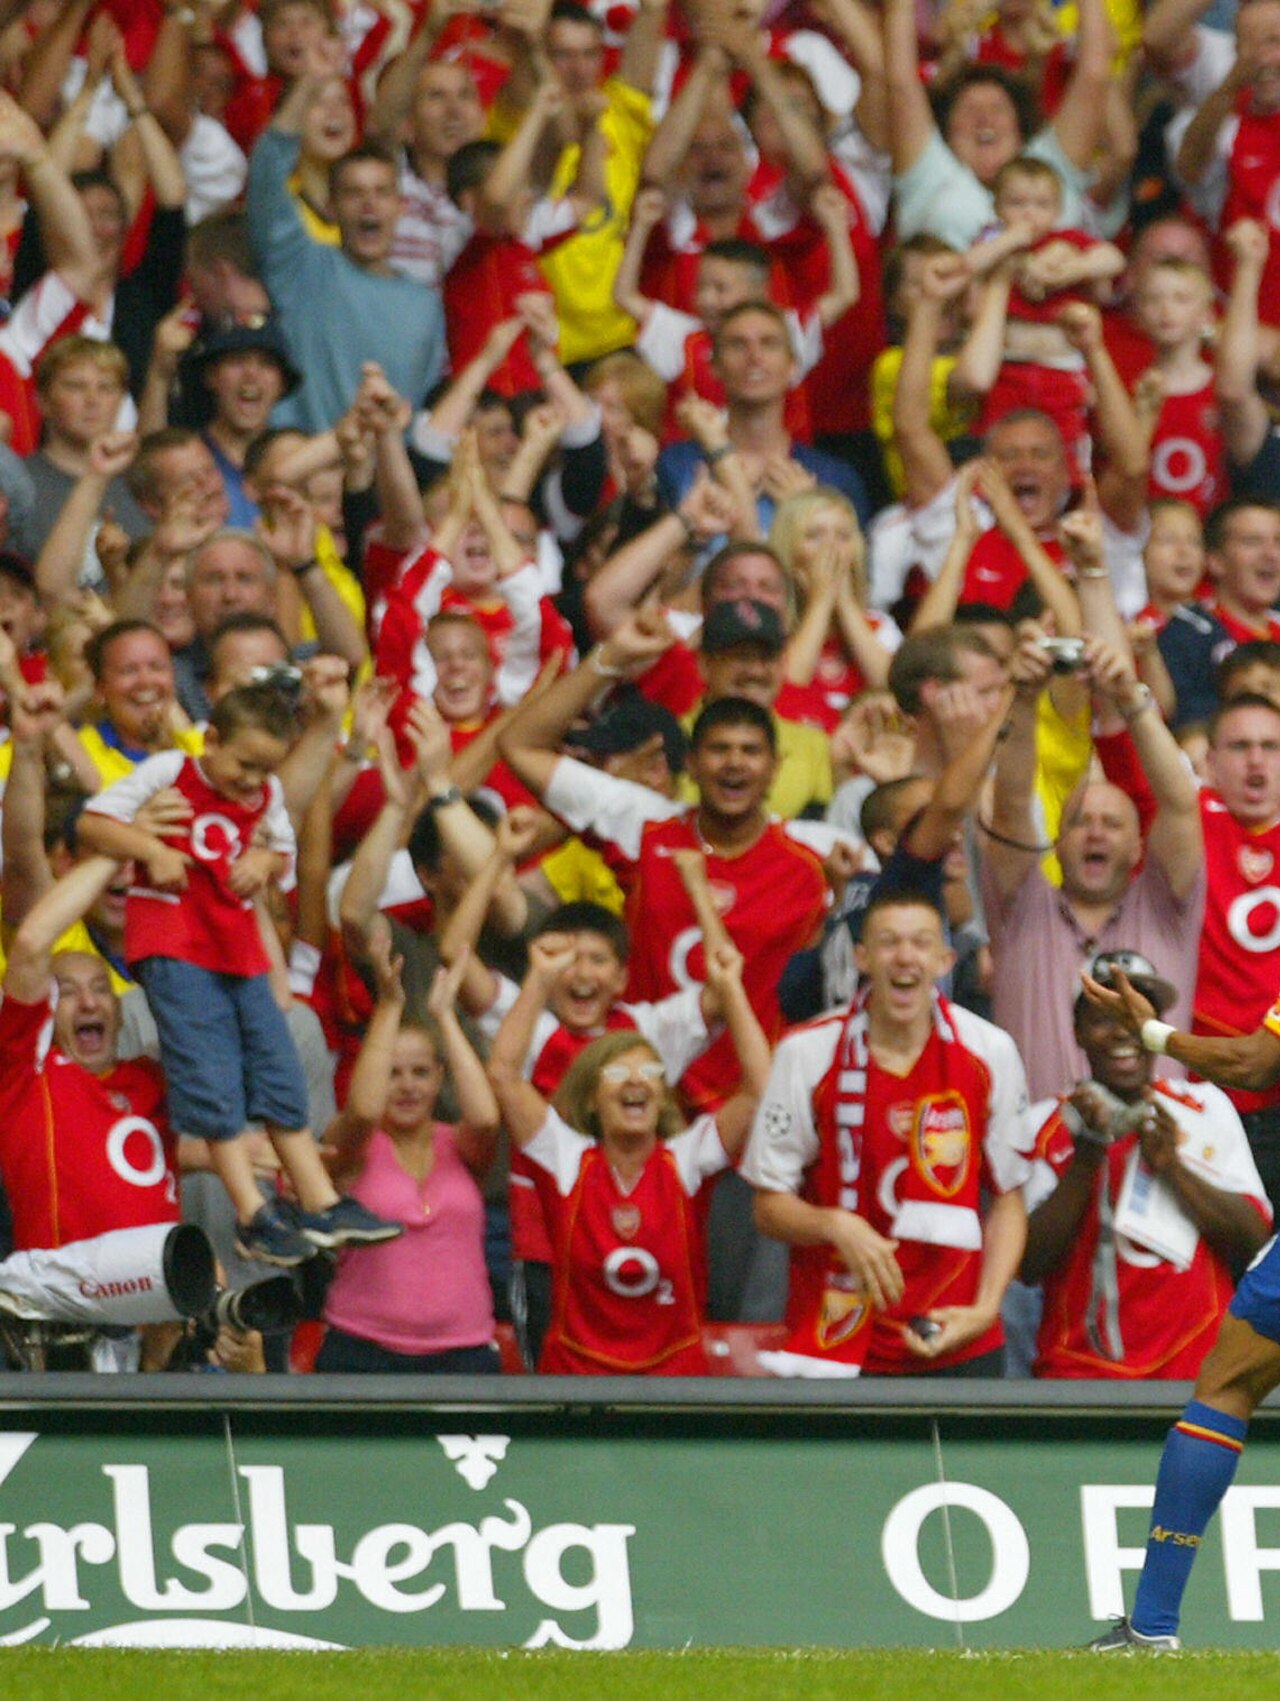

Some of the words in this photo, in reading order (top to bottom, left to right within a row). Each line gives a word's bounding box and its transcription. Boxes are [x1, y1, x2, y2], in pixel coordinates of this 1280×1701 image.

[79, 1275, 152, 1299] Canon
[604, 1246, 676, 1306] O2
[0, 1431, 636, 1651] rlsberg
